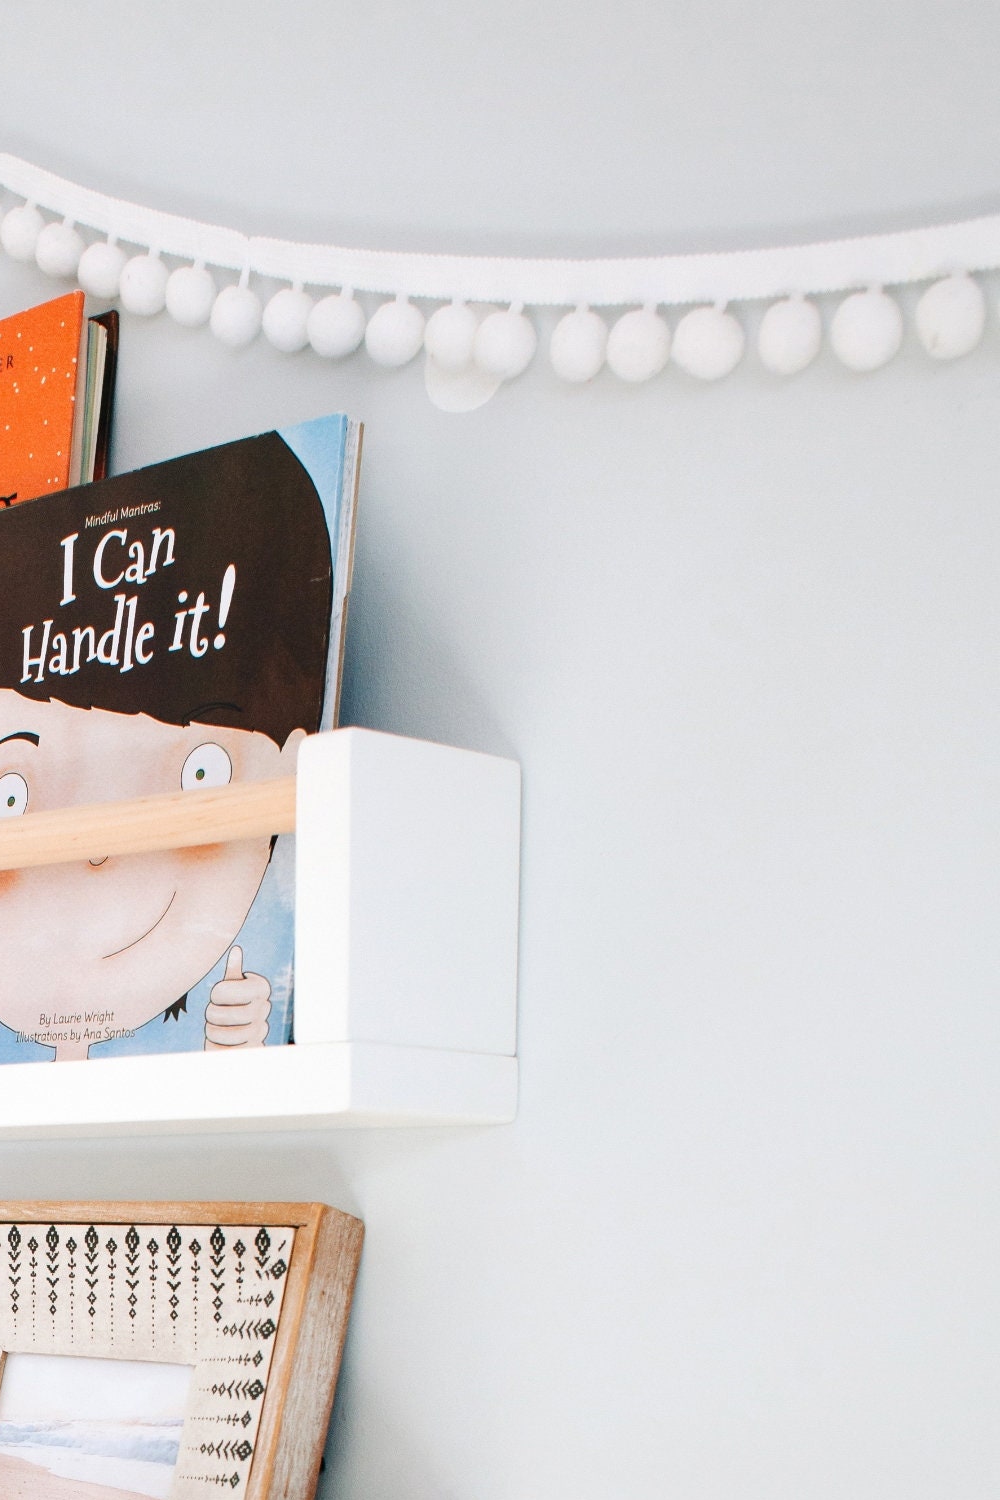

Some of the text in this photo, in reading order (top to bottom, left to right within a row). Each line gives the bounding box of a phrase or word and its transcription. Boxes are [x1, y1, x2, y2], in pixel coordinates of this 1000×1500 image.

[84, 501, 162, 529] Mindful Mantras:
[59, 525, 177, 607] I Can
[19, 563, 237, 684] Handle it!
[39, 1010, 115, 1028] By Laurie Wright
[15, 1026, 136, 1044] Illustrations by Ana Santos
